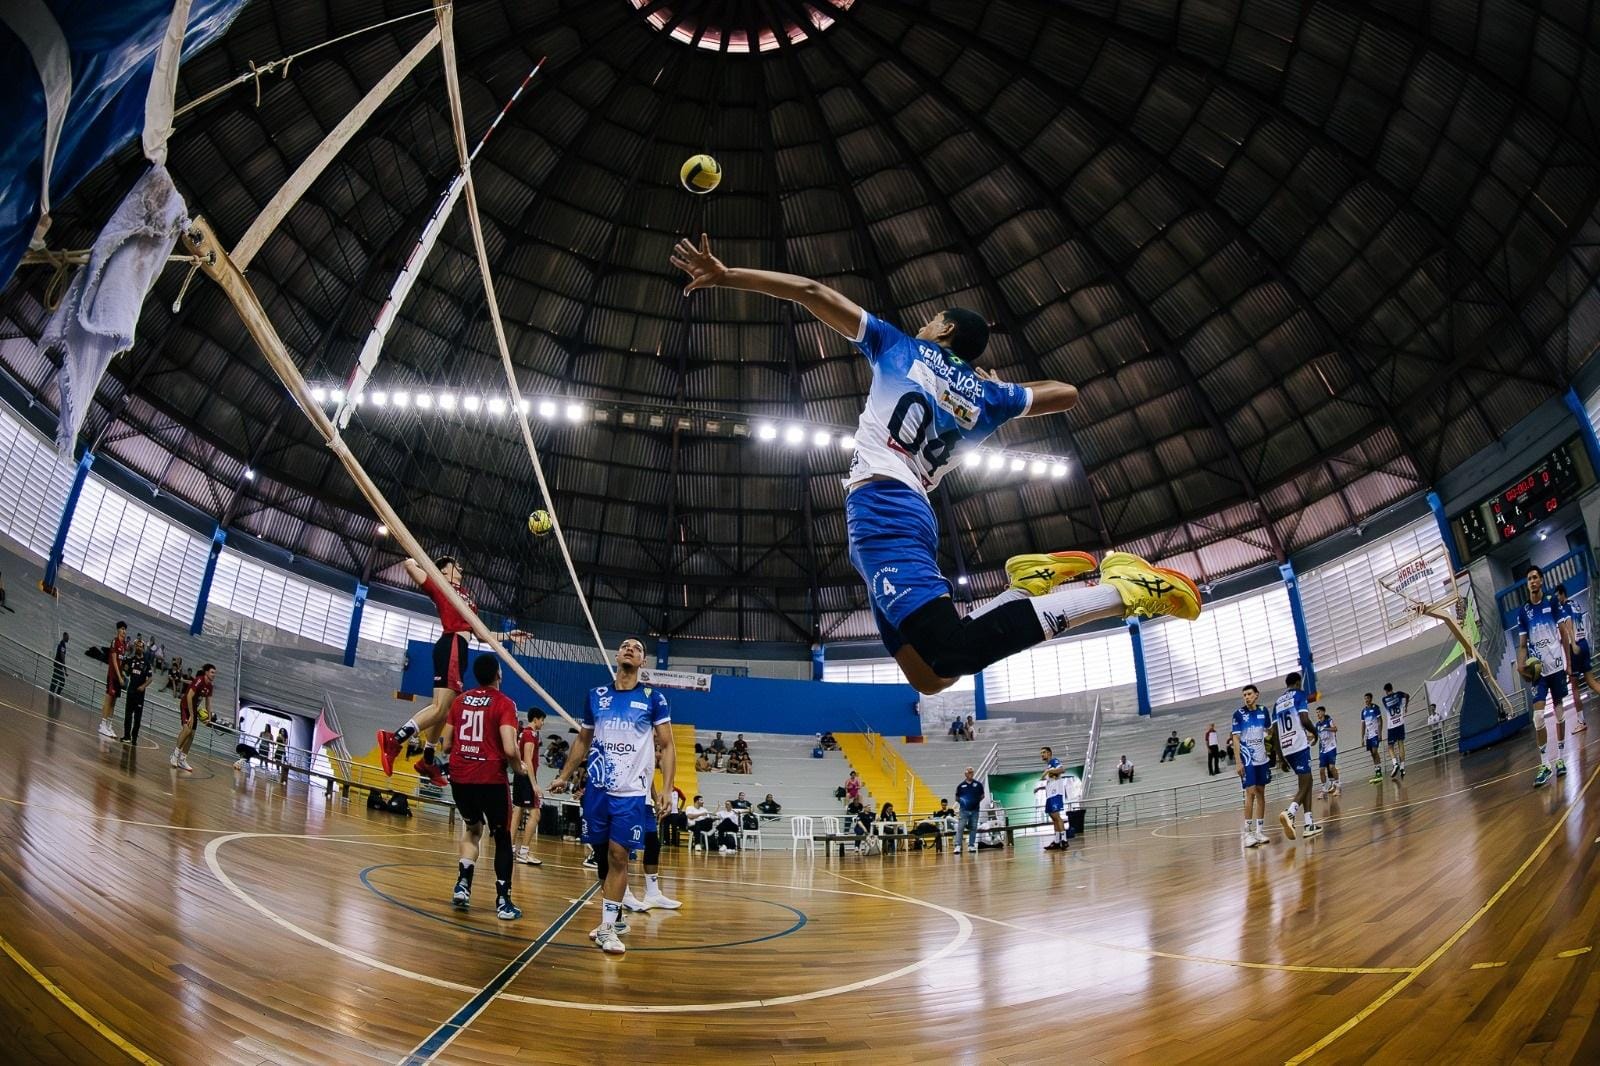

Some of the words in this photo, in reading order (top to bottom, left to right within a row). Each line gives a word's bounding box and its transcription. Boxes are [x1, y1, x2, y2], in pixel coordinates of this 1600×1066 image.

[1397, 559, 1427, 583] HARLEM
[883, 576, 897, 596] 4
[463, 695, 490, 707] SESI
[459, 709, 485, 742] 20
[1278, 711, 1293, 734] 16
[632, 829, 641, 841] 10
